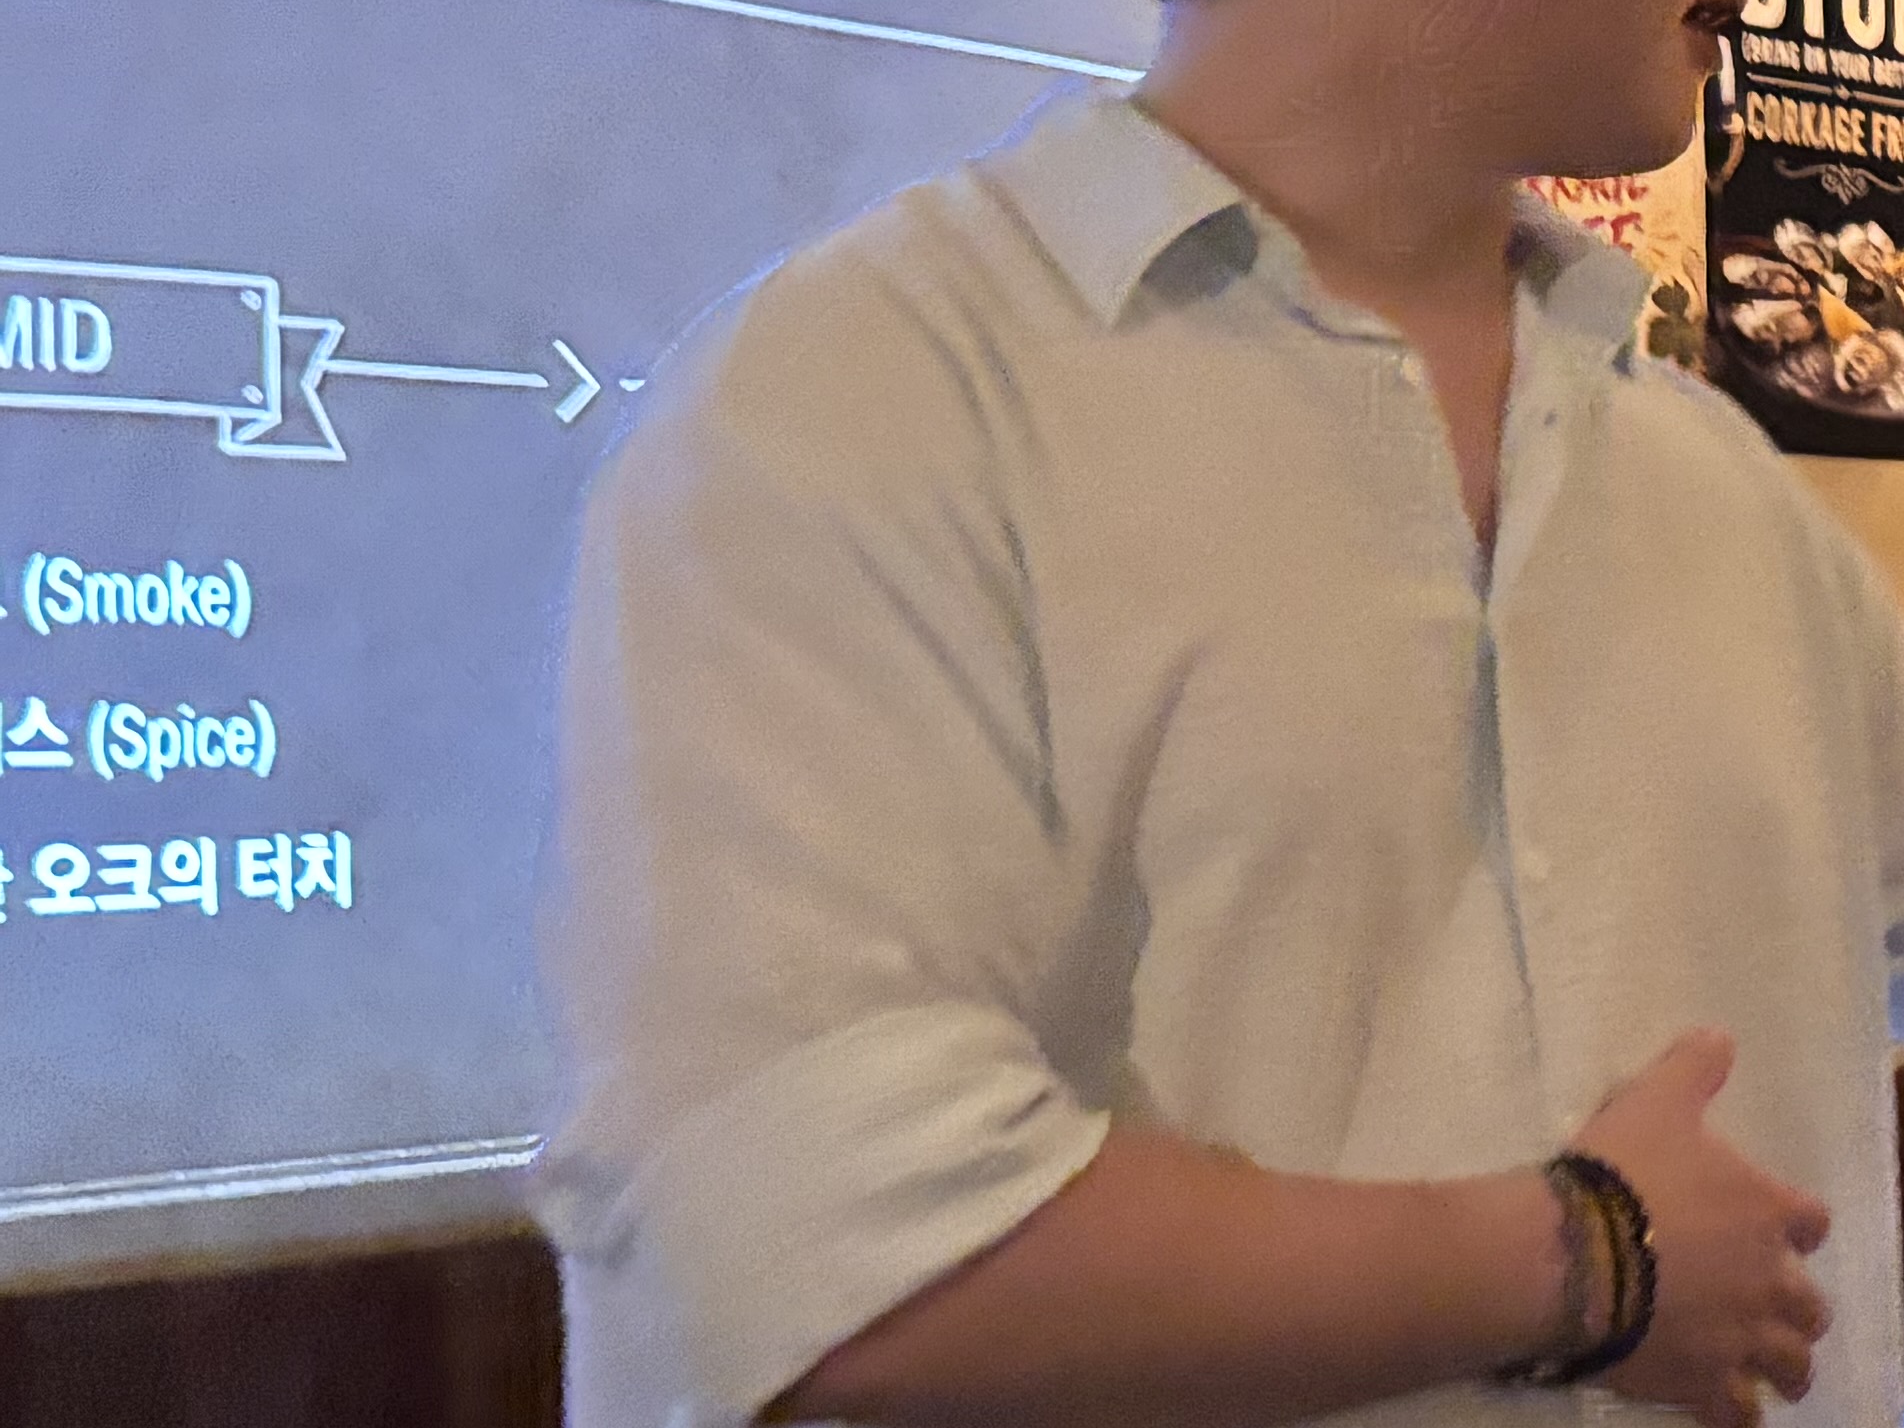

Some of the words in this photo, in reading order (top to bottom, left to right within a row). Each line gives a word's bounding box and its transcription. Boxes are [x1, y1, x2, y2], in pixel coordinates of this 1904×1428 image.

[1747, 91, 1868, 157] CORKAGE
[23, 552, 251, 639] (Smoke)
[88, 699, 276, 783] (Spice)
[25, 835, 219, 916] 오크의
[236, 830, 352, 913] 터치
